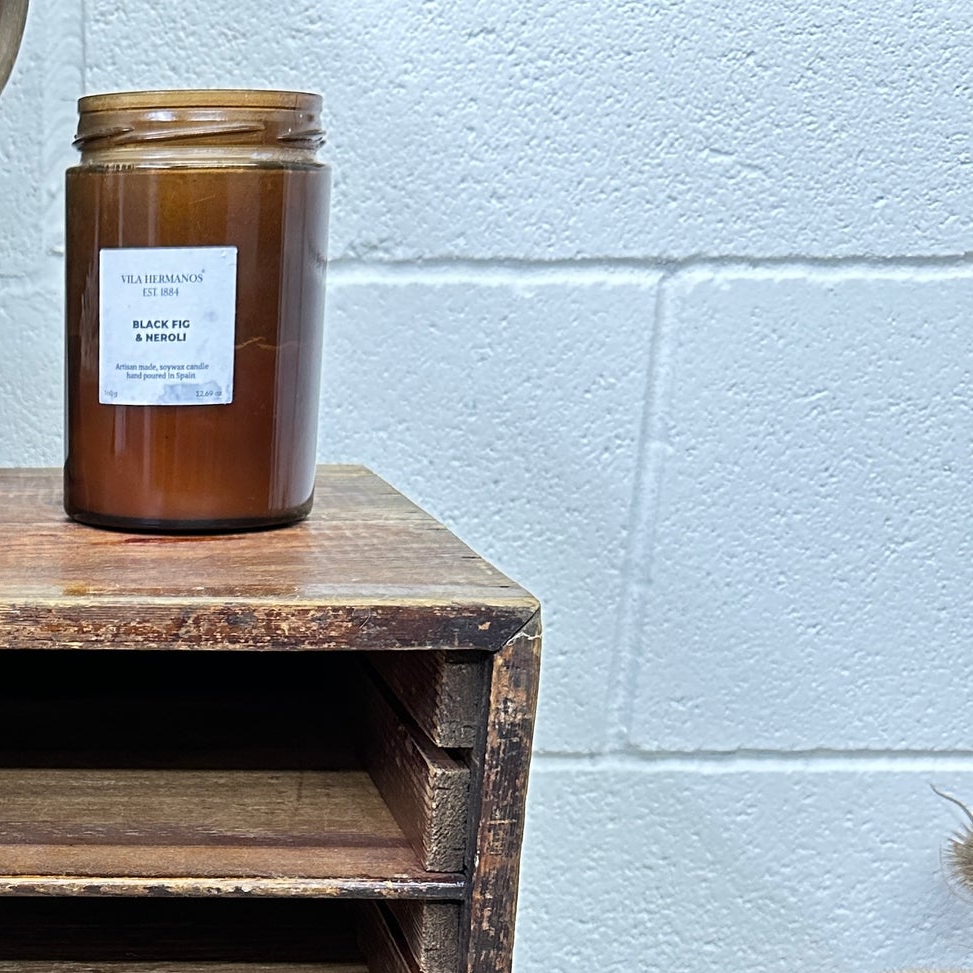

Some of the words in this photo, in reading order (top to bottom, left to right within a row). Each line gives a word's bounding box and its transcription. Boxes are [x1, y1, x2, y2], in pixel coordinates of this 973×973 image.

[121, 275, 142, 284] VILA
[145, 273, 203, 283] HERMANOS
[160, 288, 179, 297] 1884
[132, 320, 169, 329] BLACK
[172, 320, 190, 328] FIG
[135, 334, 143, 342] &
[146, 333, 187, 342] NEROLI
[115, 363, 137, 371] Artisan
[139, 363, 159, 372] made,
[159, 364, 185, 372] soywax
[143, 372, 166, 380] poured
[176, 372, 196, 380] Spain
